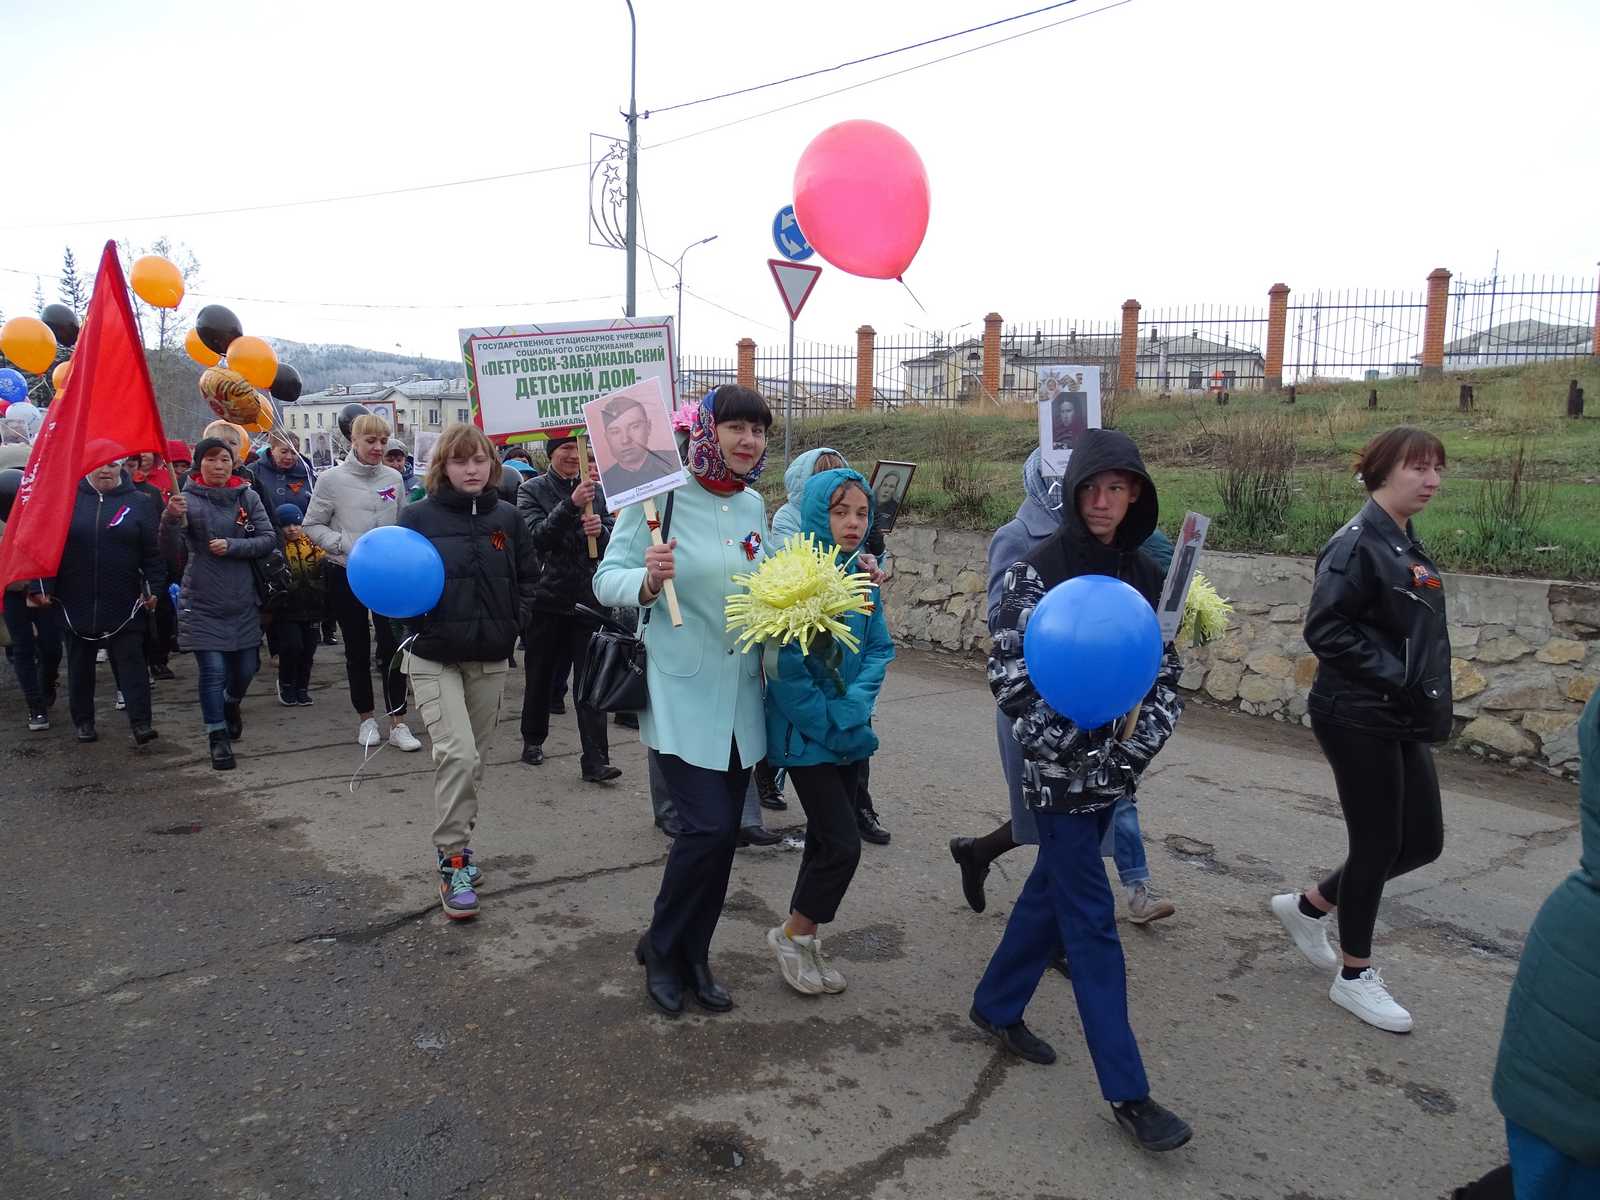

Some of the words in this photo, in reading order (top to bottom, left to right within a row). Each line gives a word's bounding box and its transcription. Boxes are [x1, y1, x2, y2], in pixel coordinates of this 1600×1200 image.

[477, 339, 554, 350] ГОСУДАРСТВЕННОЕ
[555, 335, 614, 346] СТАЦИОНАРНОЕ
[615, 331, 663, 342] УЧРЕЖДЕНИЕ
[516, 347, 573, 357] СОЦИАЛЬНОГО
[574, 342, 635, 353] ОБСЛУЖИВАНИЯ
[481, 346, 666, 376] «ПЕТРОВСК-ЗАБАЙКАЛЬСКИЙ
[515, 369, 595, 400] ДЕТСКИЙ
[598, 368, 642, 392] ДОМ-
